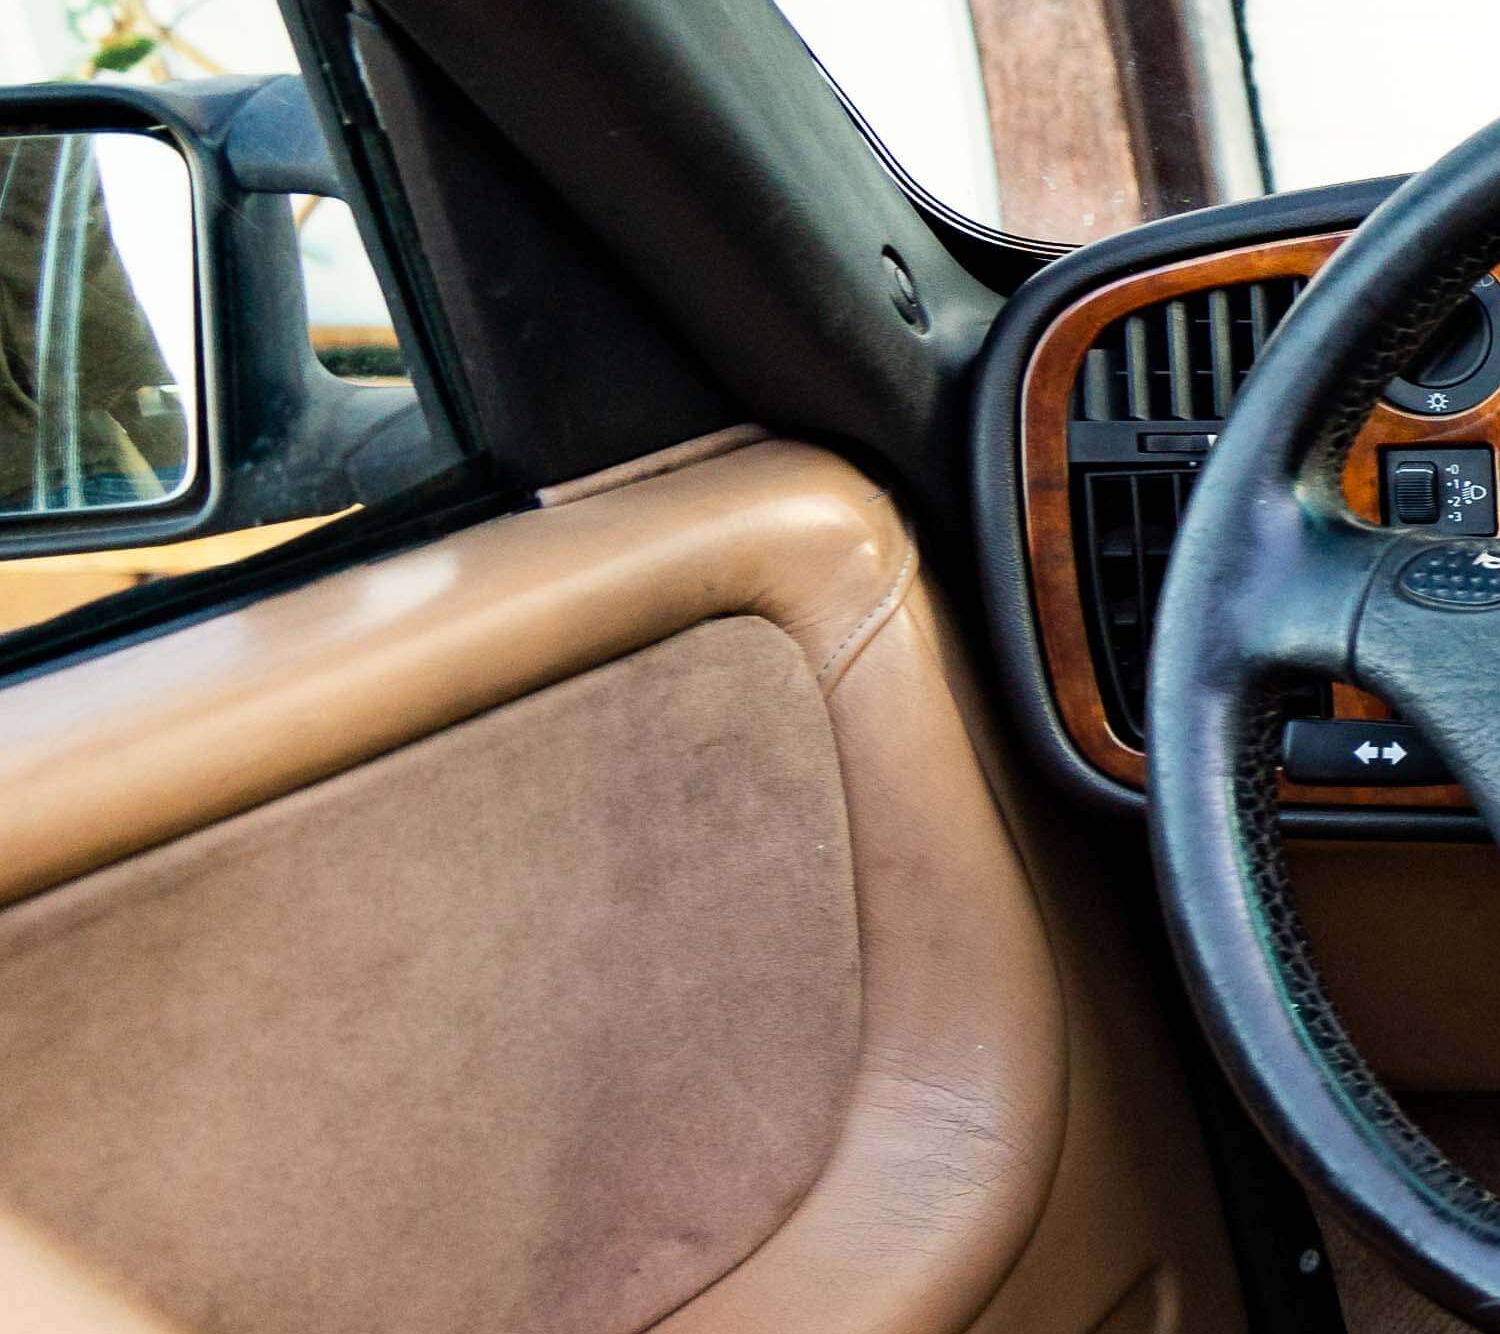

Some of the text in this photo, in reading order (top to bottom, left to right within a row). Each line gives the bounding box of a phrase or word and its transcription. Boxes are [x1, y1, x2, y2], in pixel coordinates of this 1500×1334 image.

[1450, 463, 1460, 475] 0
[1453, 478, 1460, 489] 1
[1453, 495, 1461, 507] 2
[1453, 510, 1463, 522] 3
